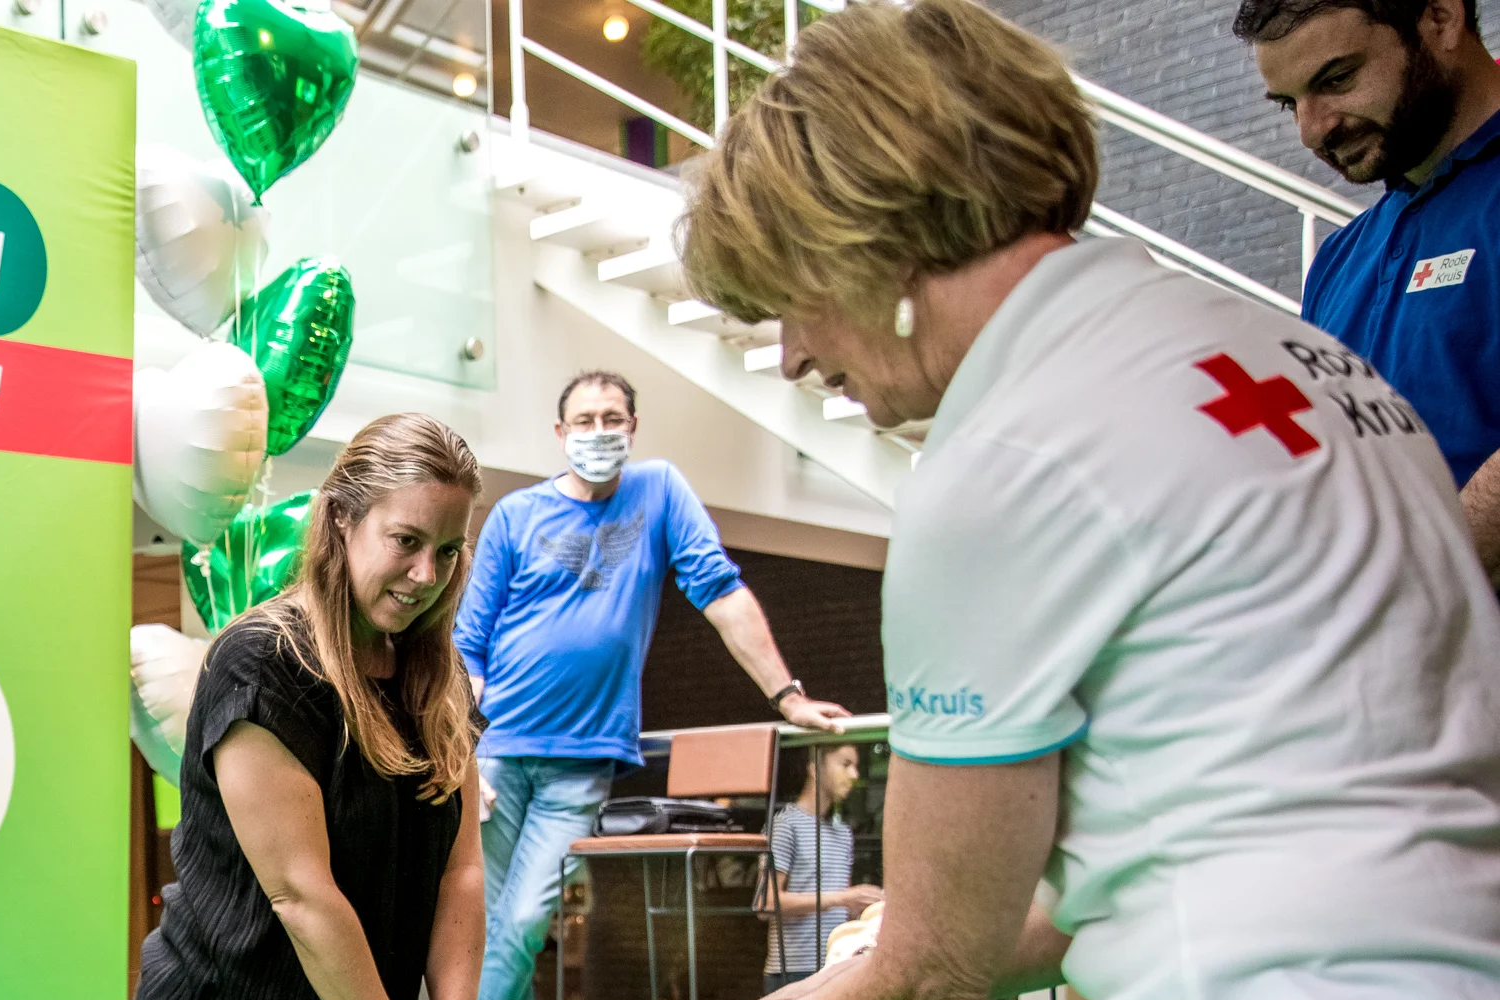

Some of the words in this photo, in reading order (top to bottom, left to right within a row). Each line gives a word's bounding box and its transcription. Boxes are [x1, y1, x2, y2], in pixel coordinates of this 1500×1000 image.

[1440, 254, 1469, 270] Rode
[1434, 268, 1463, 285] Kruis
[908, 686, 987, 720] Kruis
